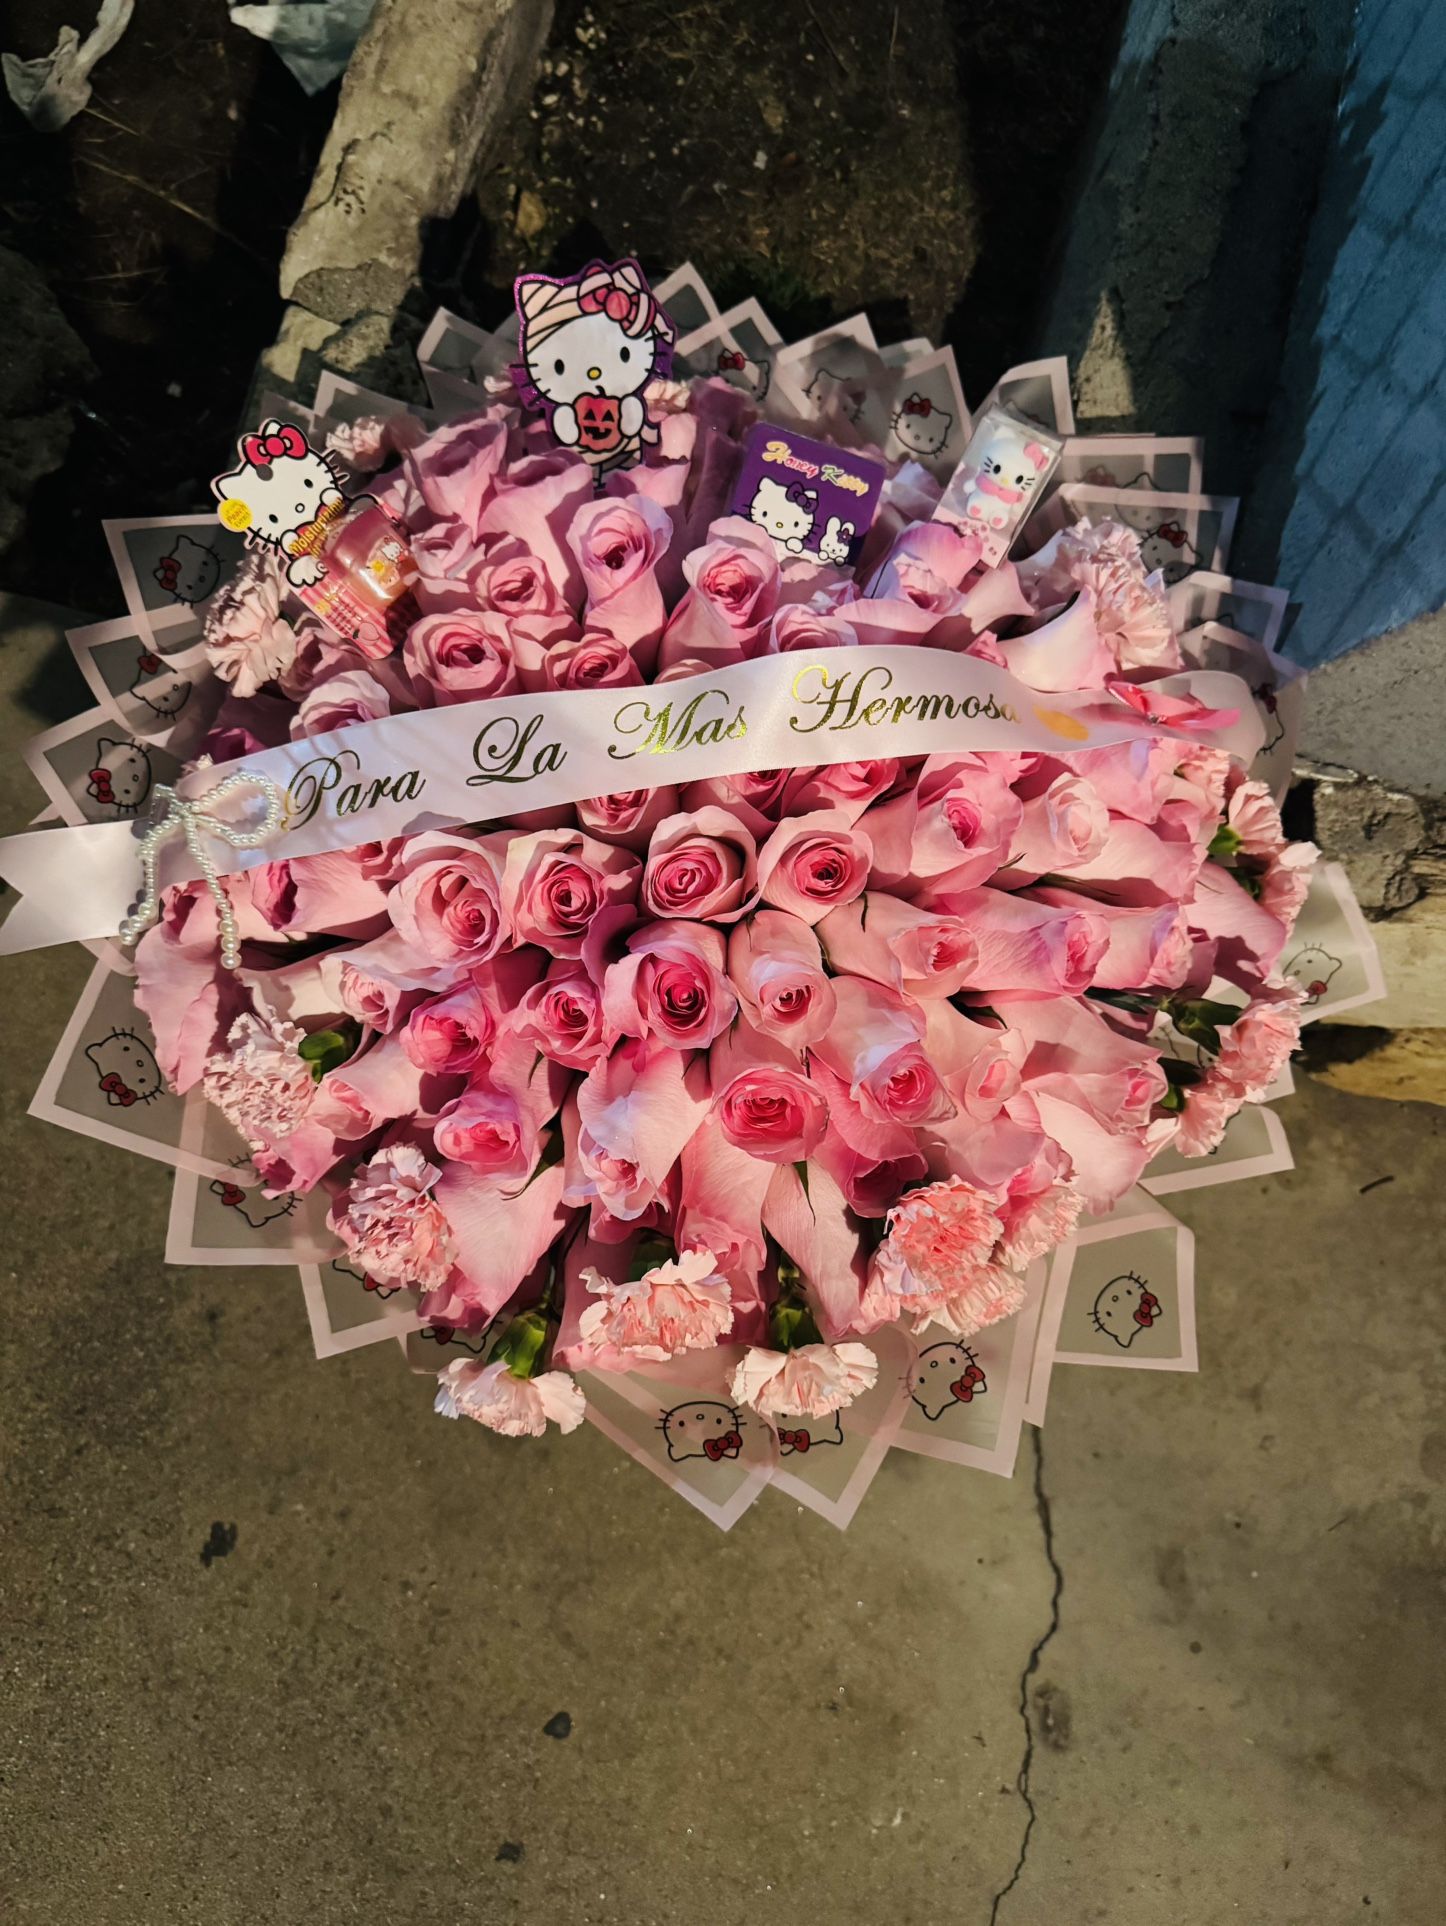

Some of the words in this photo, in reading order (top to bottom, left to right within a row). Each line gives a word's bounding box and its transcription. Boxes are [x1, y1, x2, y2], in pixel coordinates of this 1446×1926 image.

[761, 441, 820, 479] Honey
[280, 749, 425, 832] Para
[466, 714, 568, 788] La
[607, 689, 749, 761] Mas
[788, 664, 1022, 734] Hermosa
